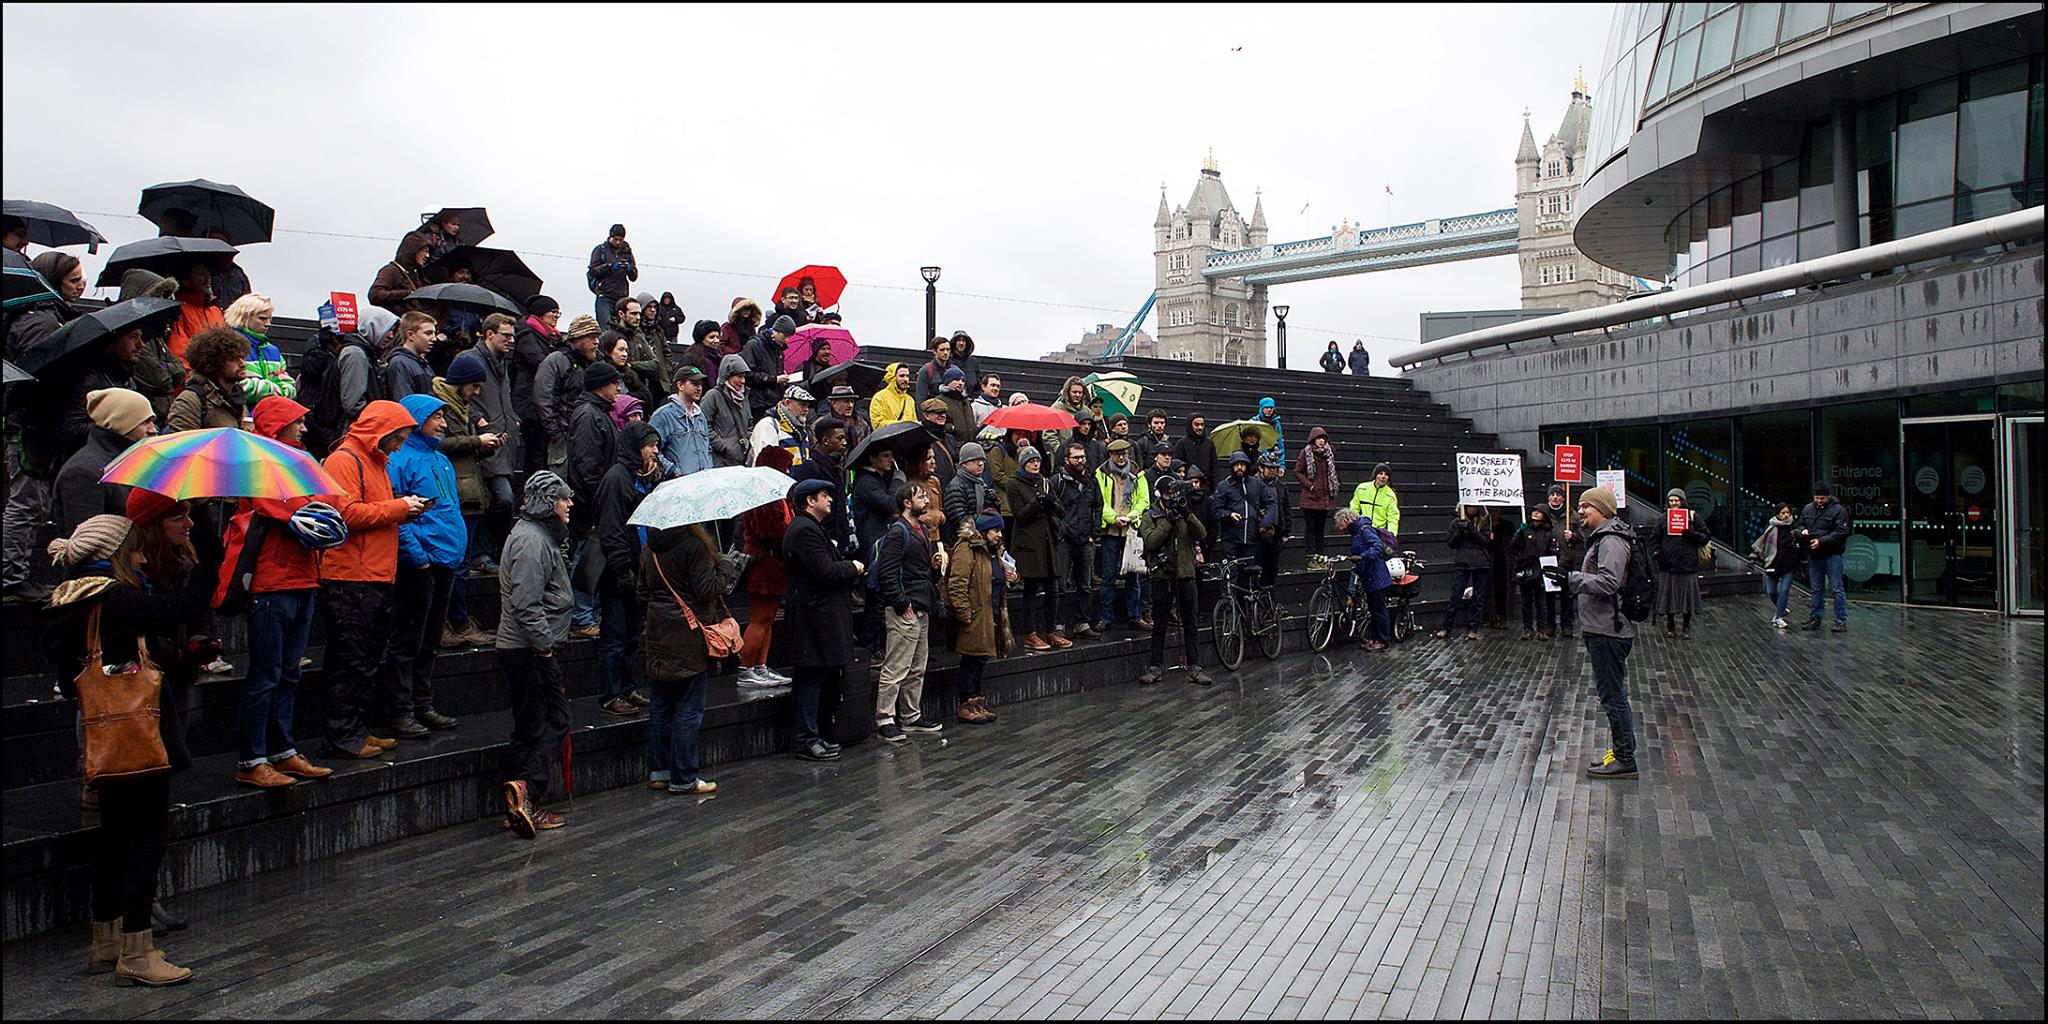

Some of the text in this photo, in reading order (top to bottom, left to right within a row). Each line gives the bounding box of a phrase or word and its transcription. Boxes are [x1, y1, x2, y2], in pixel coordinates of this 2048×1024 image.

[1460, 466, 1514, 477] PLEASE SAY
[1831, 464, 1882, 478] Entrance
[1483, 477, 1499, 487] NO
[1460, 488, 1524, 498] TO THE BRIDGE
[1833, 483, 1881, 500] Through
[1855, 502, 1891, 516] Doors
